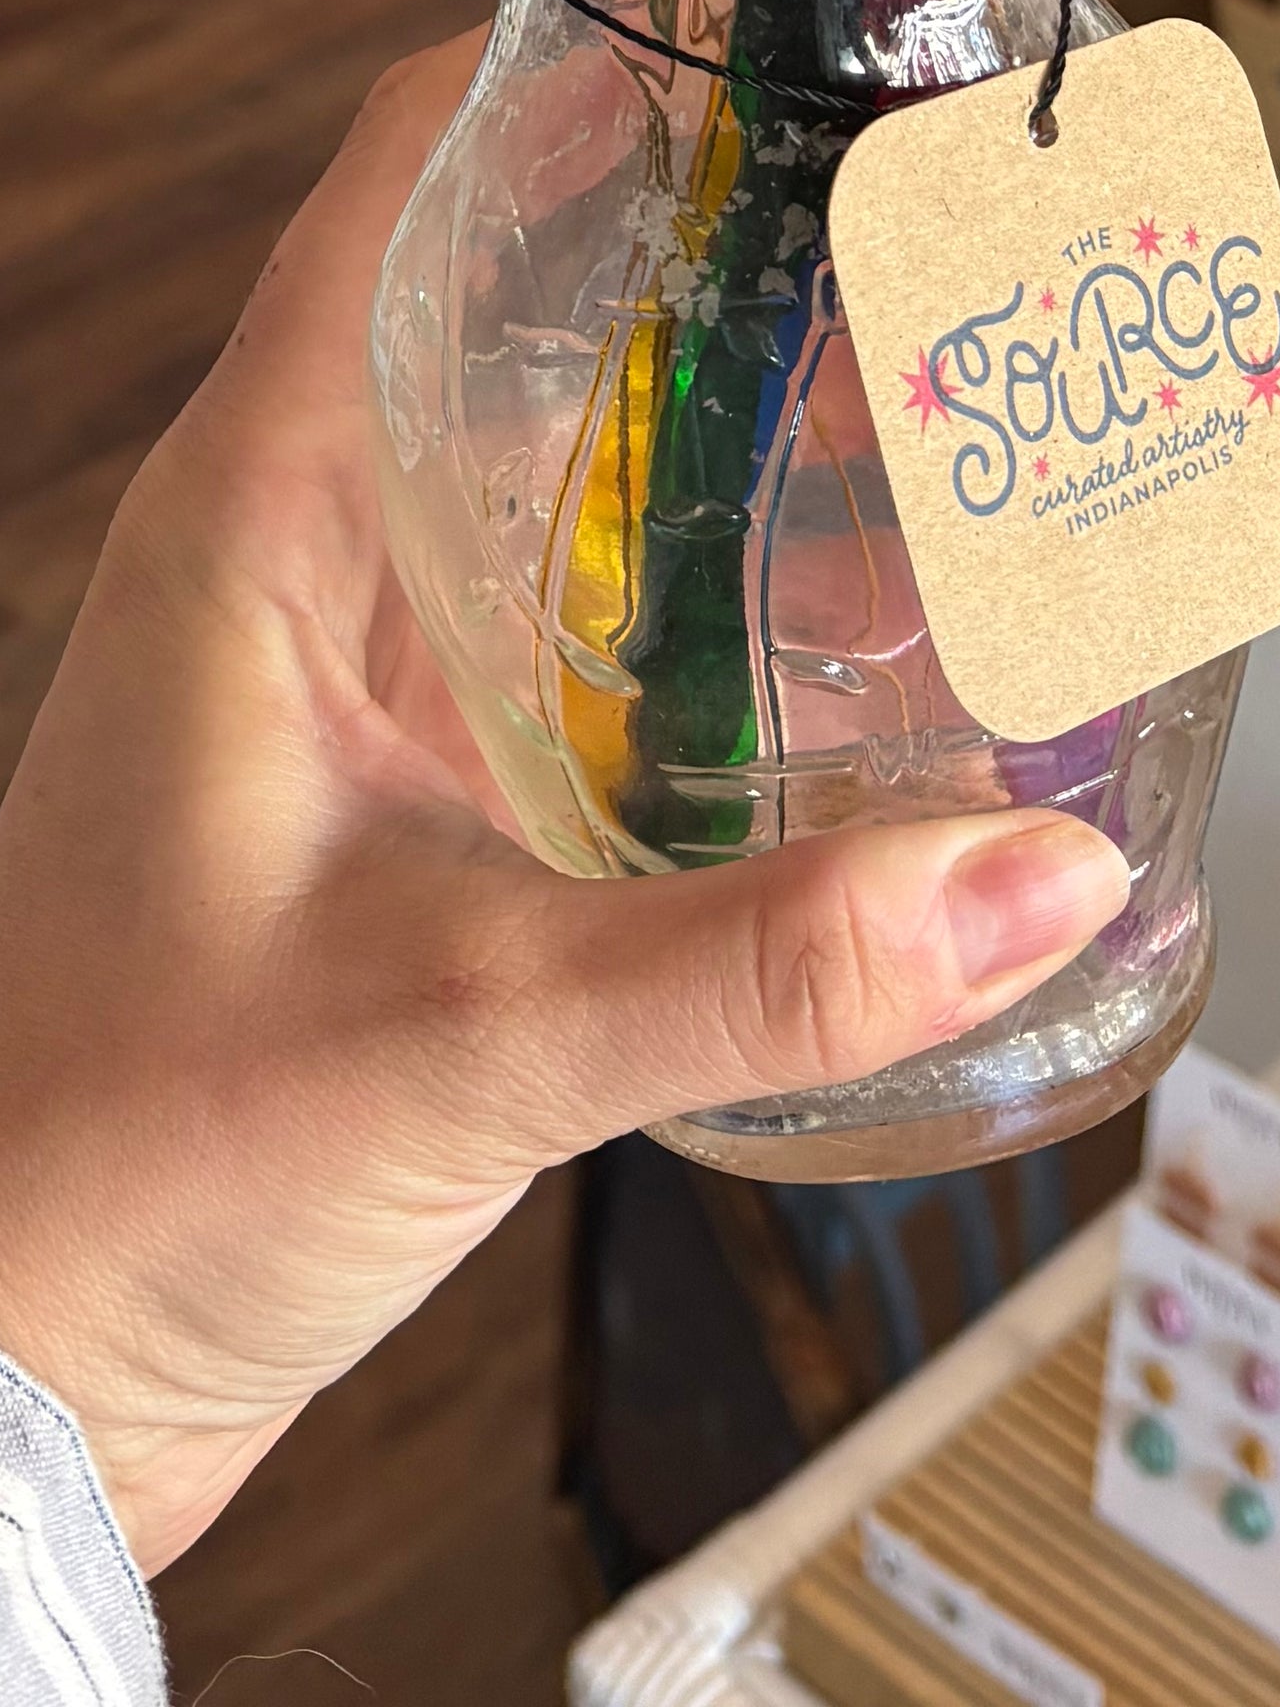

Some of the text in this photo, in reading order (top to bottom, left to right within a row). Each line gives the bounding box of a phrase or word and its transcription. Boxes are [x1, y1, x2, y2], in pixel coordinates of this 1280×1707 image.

[1061, 227, 1113, 266] THE
[1031, 406, 1251, 519] curated artistry
[1064, 445, 1236, 536] INDIANAPOLIS
